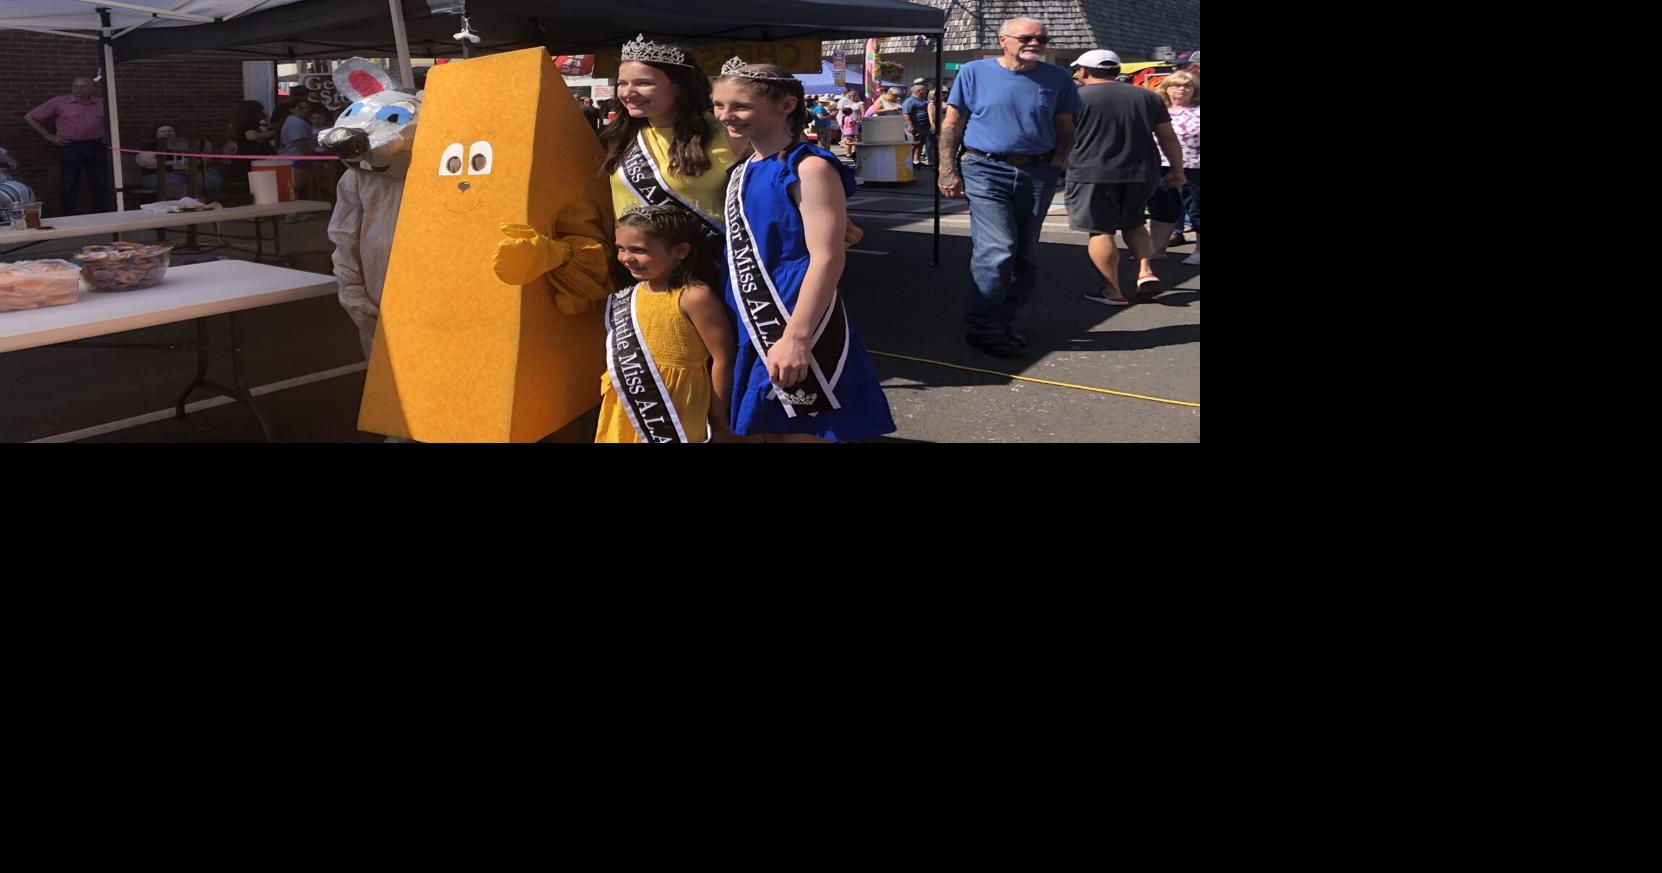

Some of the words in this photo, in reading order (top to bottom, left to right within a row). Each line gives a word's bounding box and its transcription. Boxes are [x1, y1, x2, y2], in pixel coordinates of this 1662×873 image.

[305, 77, 334, 90] Ge
[625, 145, 645, 183] Miss
[734, 244, 757, 293] Miss
[614, 308, 632, 350] Little
[619, 352, 645, 394] Miss
